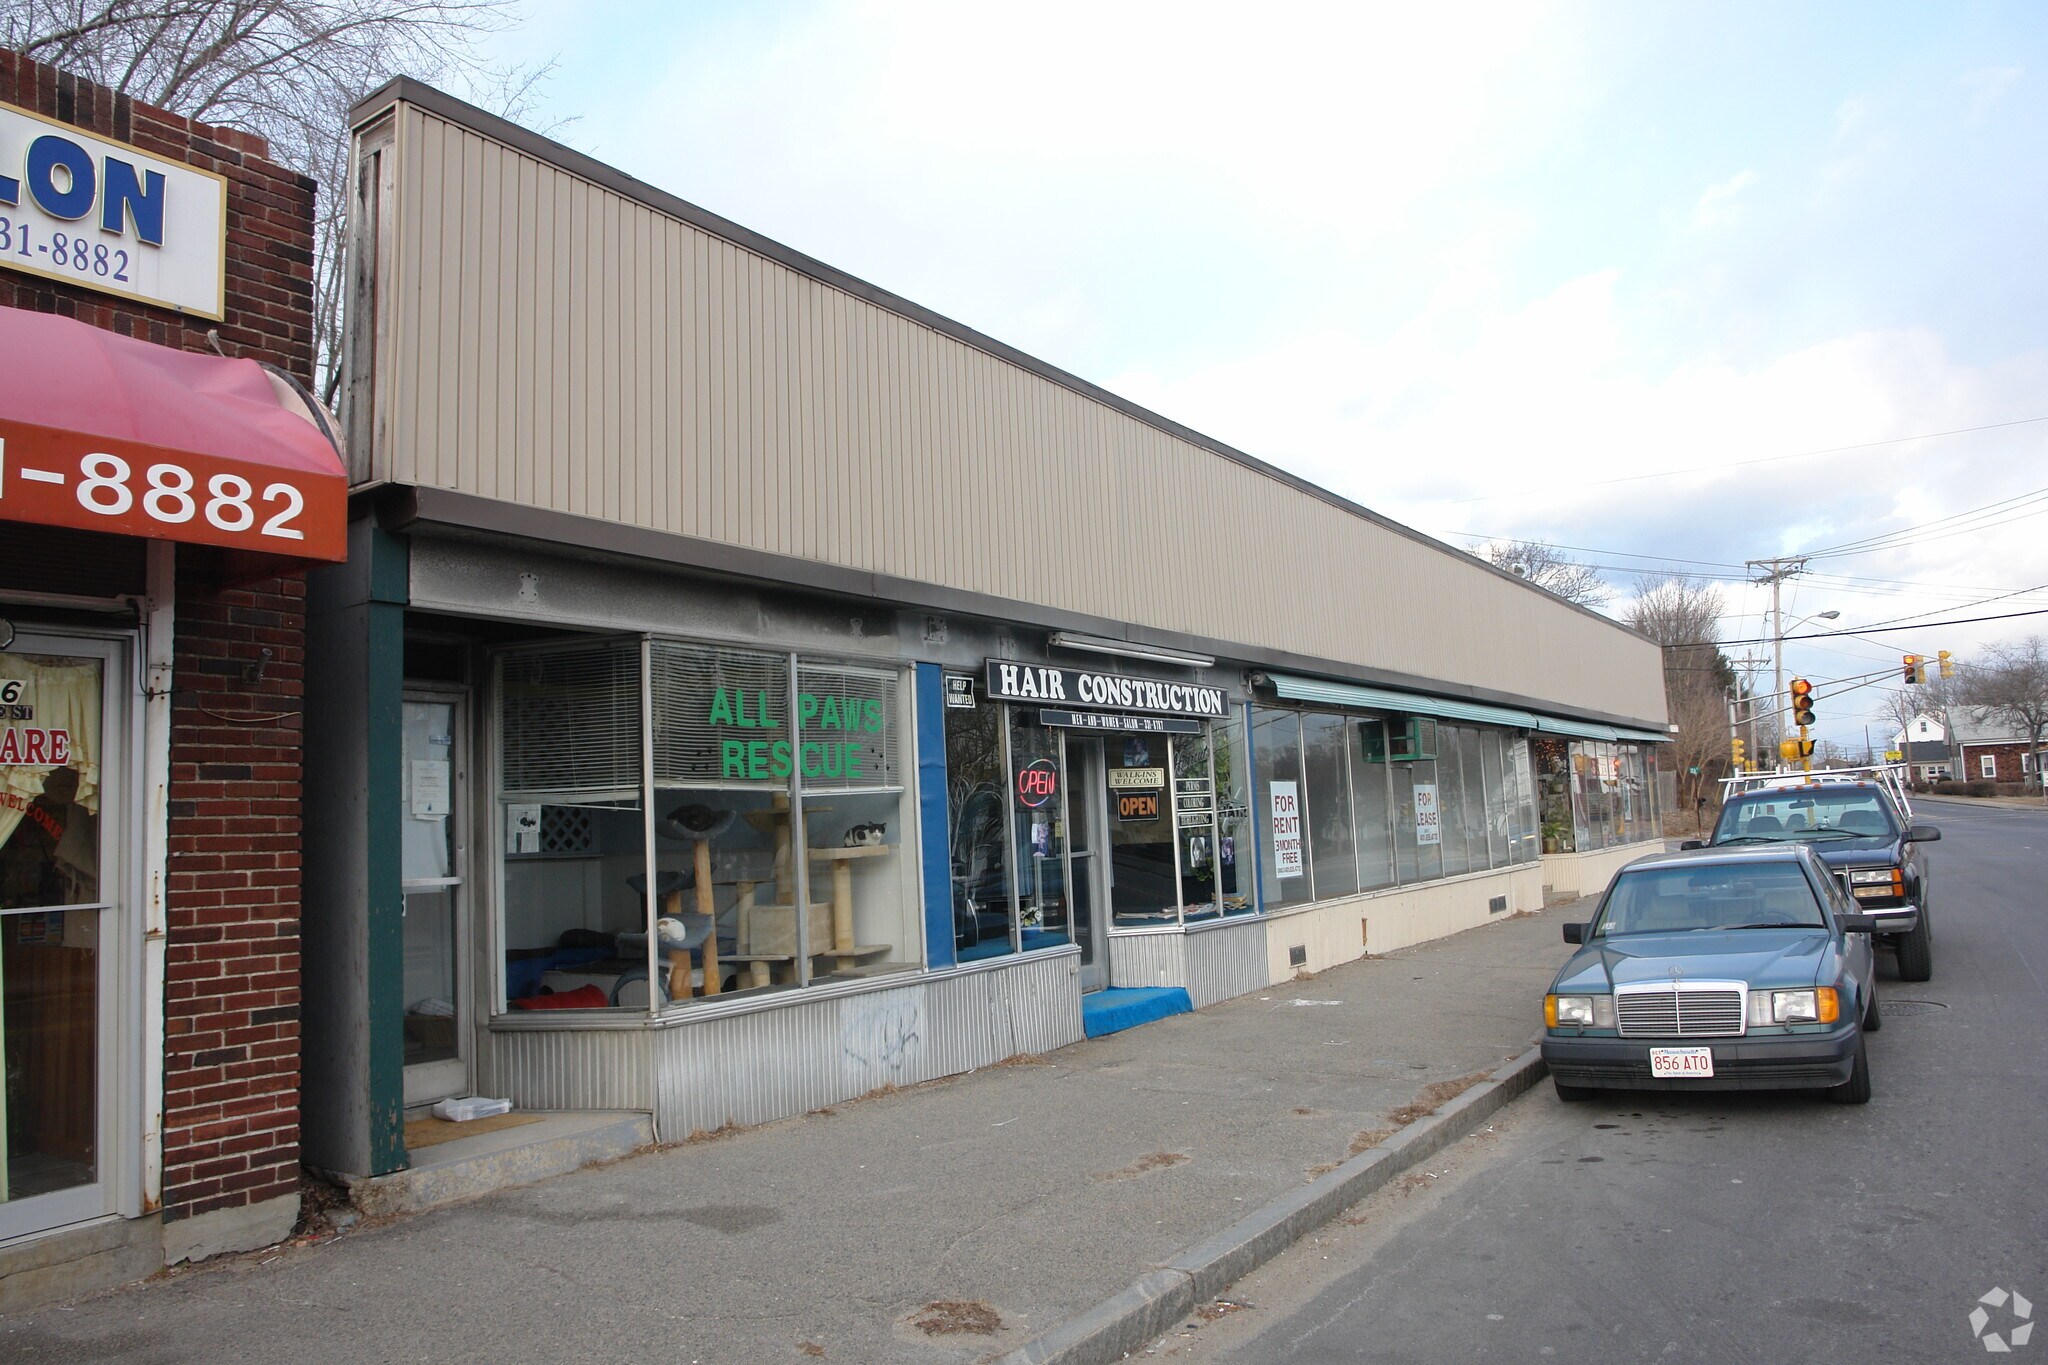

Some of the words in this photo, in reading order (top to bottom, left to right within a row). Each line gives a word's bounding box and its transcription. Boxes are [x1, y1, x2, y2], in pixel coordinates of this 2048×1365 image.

[0, 133, 168, 248] ON
[0, 437, 304, 541] -8882
[1, 681, 22, 703] 6
[952, 680, 967, 692] HELP
[1000, 664, 1066, 700] HAIR
[1078, 673, 1223, 715] CONSTRUCTION
[948, 692, 973, 705] WANTED
[12, 705, 33, 720] ST
[709, 687, 779, 728] ALL
[799, 693, 883, 734] PAWS
[1123, 718, 1139, 730] SALON
[0, 727, 71, 766] ARE
[722, 740, 864, 780] RESCUE
[1019, 770, 1056, 794] OPEN
[1120, 796, 1157, 816] OPEN
[1274, 795, 1295, 812] FOR
[1417, 792, 1432, 806] FOR
[1273, 817, 1298, 834] RENT
[1416, 812, 1437, 826] LEASE
[1282, 852, 1299, 864] FREE
[1654, 1056, 1680, 1070] 856
[1684, 1056, 1708, 1070] ATO
